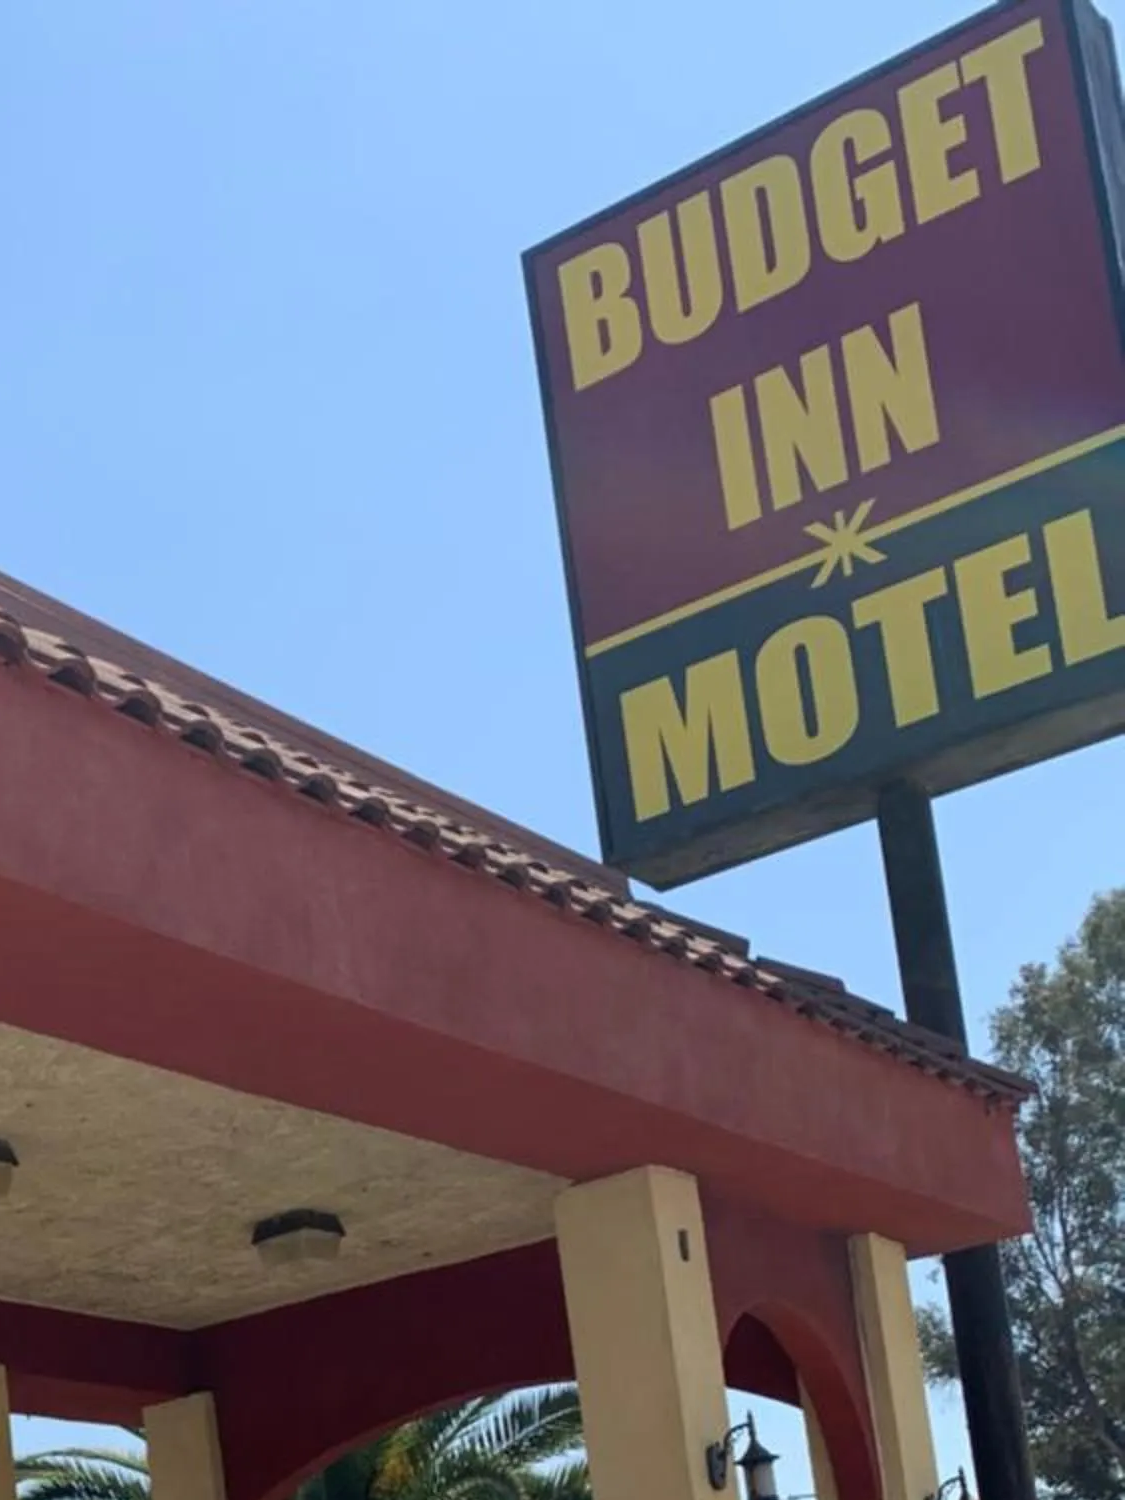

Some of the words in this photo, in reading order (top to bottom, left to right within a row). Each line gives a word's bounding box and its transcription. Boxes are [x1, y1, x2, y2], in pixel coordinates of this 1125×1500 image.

[558, 19, 1043, 391] BUDGET
[709, 304, 940, 530] INN
[620, 510, 1125, 820] MOTEL
